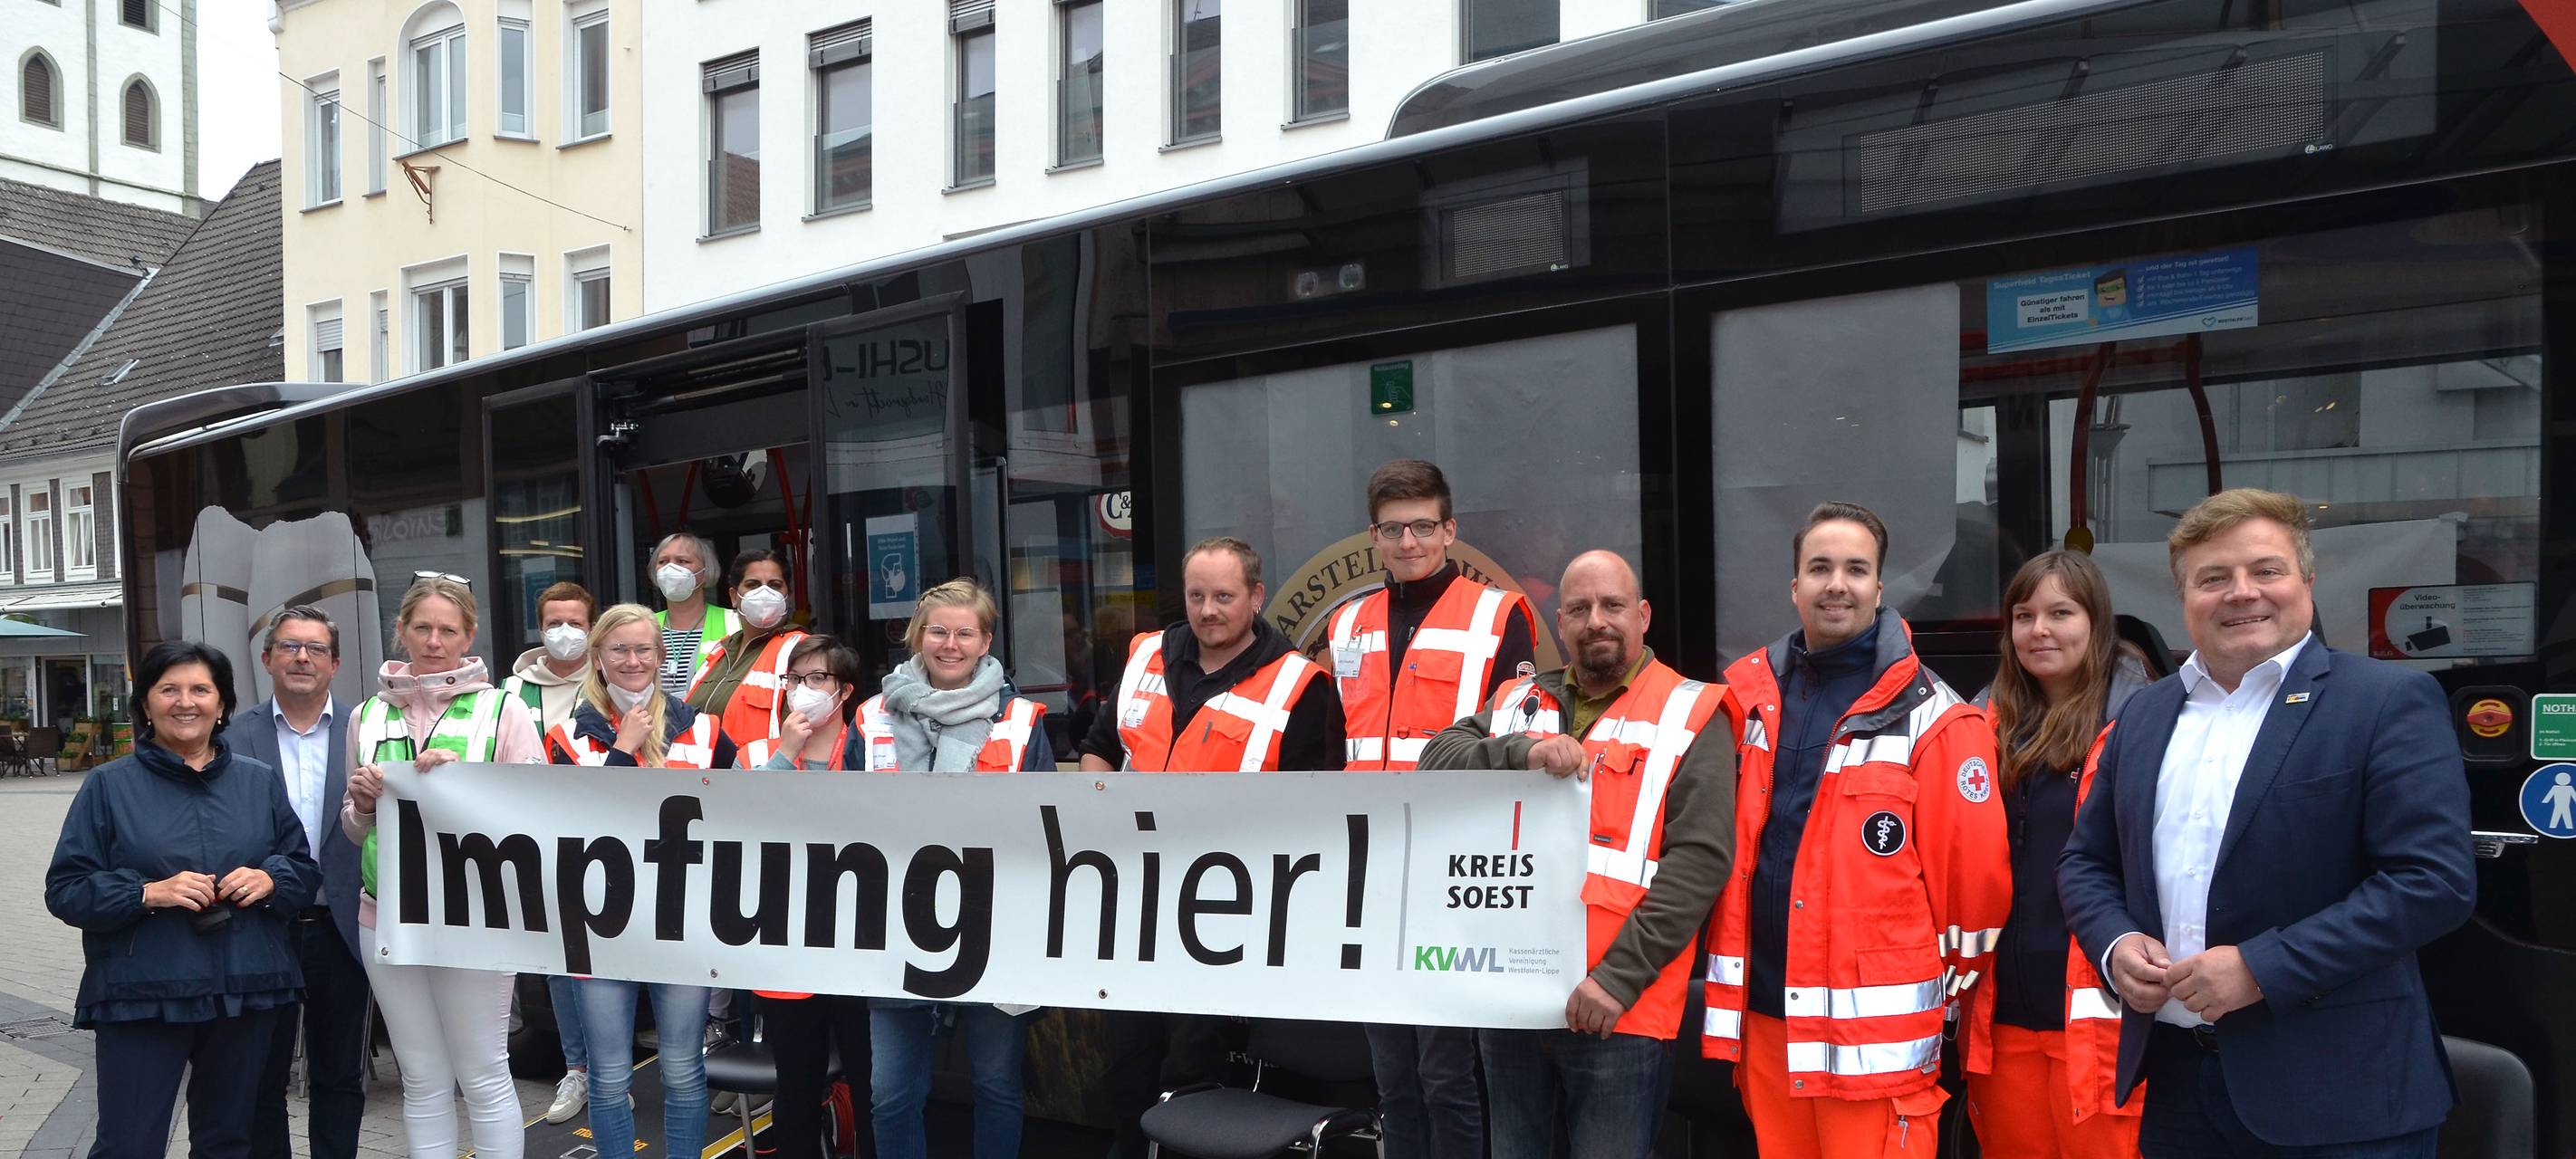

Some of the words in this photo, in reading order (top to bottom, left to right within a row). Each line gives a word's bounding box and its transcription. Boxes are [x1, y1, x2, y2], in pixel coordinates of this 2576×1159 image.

[2021, 296, 2058, 308] Günstiger
[2060, 294, 2085, 302] fahren
[2052, 304, 2066, 312] mit
[2027, 312, 2079, 323] EinzelTickets
[1107, 493, 1131, 519] C&
[2414, 594, 2441, 602] Video-
[2399, 601, 2456, 610] überwachung
[2542, 704, 2576, 713] NOTH
[1960, 781, 1978, 800] ROTES
[1448, 853, 1534, 877] KREIS
[397, 794, 995, 999] Impfung
[1040, 804, 1370, 970] hier!
[1447, 885, 1534, 909] SOEST
[1415, 945, 1504, 972] KVWL
[1508, 957, 1547, 965] Vereinigung
[1508, 966, 1560, 975] Westfalen-Lippe
